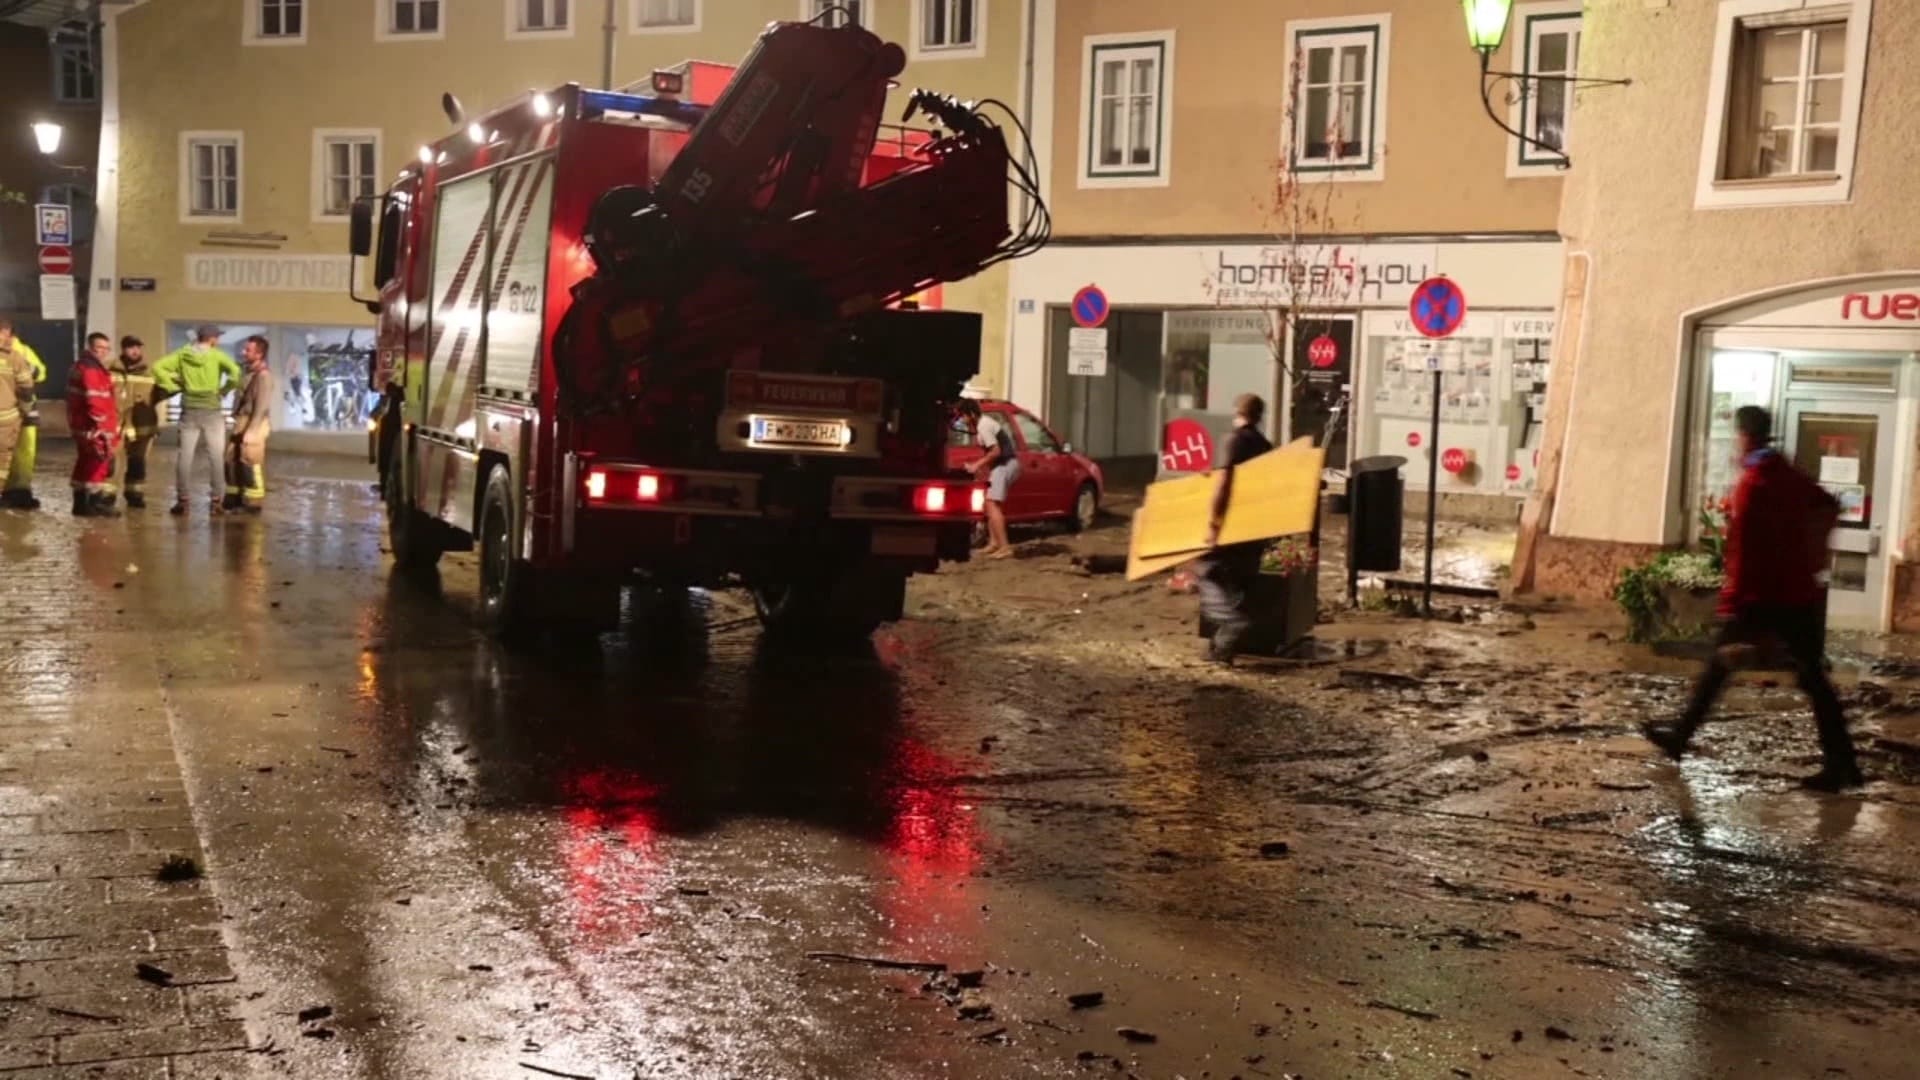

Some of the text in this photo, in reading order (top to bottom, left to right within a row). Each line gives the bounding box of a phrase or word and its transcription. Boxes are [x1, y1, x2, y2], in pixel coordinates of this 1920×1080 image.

[680, 167, 714, 205] 135
[521, 284, 538, 313] 122
[1841, 292, 1920, 321] rue
[1174, 316, 1266, 330] VERMIETUNG
[762, 382, 847, 402] FEUERWEHR
